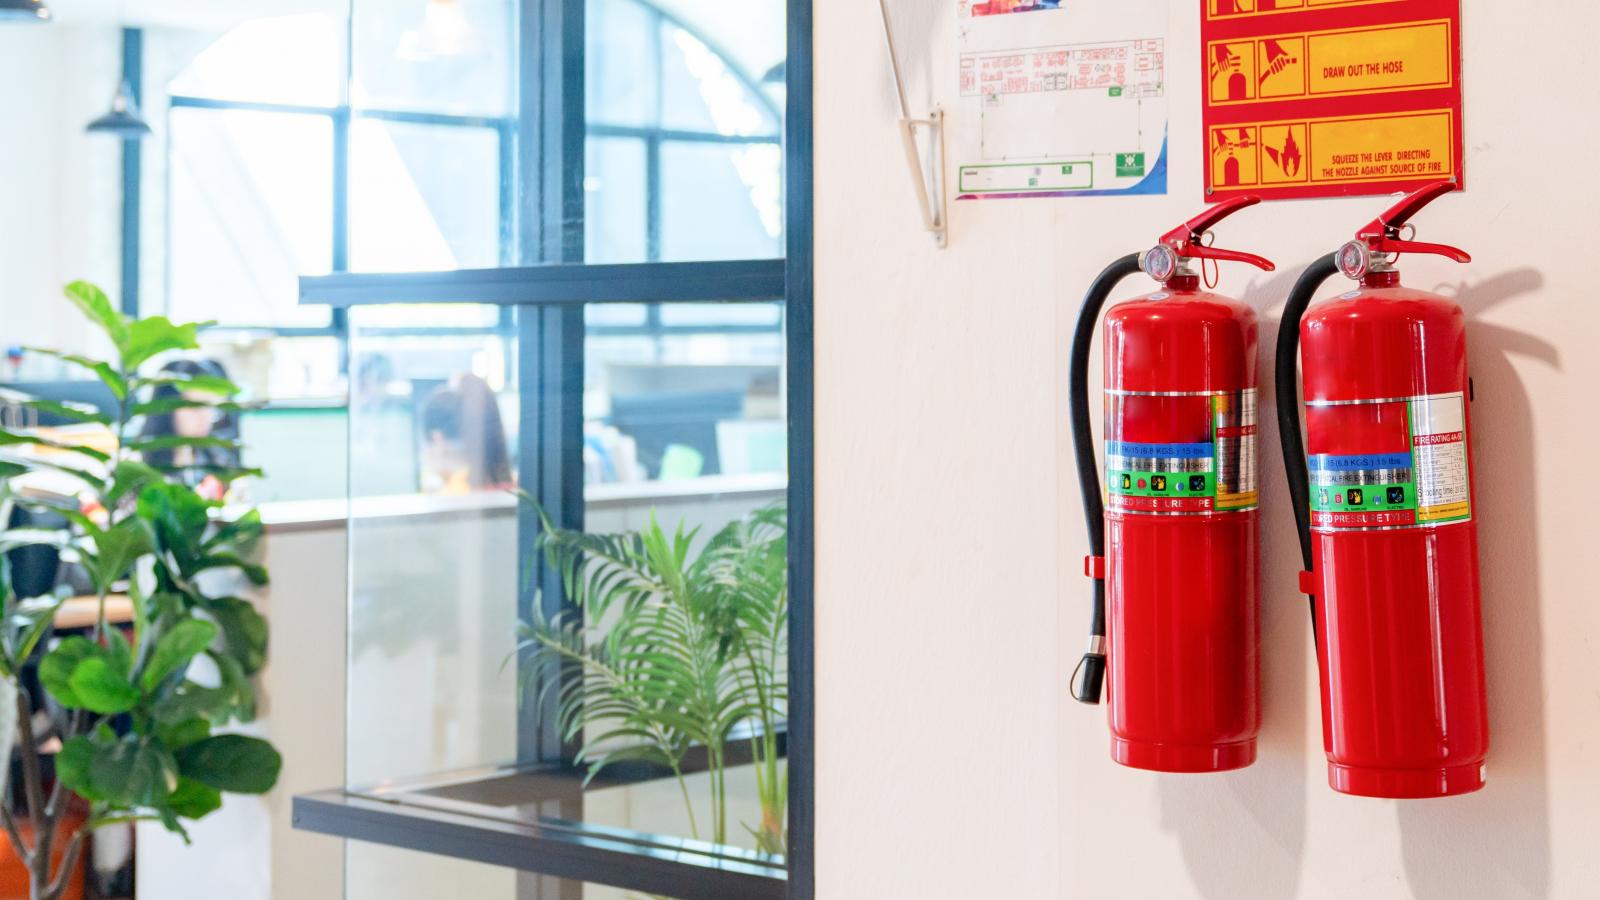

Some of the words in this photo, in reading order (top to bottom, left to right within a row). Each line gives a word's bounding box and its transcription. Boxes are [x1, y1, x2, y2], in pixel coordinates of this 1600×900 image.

[1323, 65, 1345, 79] DRAW
[1348, 64, 1363, 77] OUT
[1366, 63, 1380, 75] THE
[1382, 61, 1404, 74] HOSE
[1332, 153, 1359, 165] SQUEEZE
[1361, 153, 1373, 163] THE
[1374, 151, 1392, 162] LEVER
[1397, 149, 1431, 161] DIRECTING
[1322, 167, 1334, 177] THE
[1335, 166, 1359, 176] NOZZLE
[1361, 165, 1388, 175] AGAINST
[1389, 163, 1415, 174] SOURCE
[1417, 162, 1426, 172] OF
[1428, 161, 1442, 171] FIRE
[1414, 436, 1430, 445] FIRE
[1430, 434, 1450, 444] RATING
[1338, 474, 1353, 483] FIRE
[1354, 472, 1406, 482] EXTINGUISHER
[1418, 487, 1443, 498] Sooting
